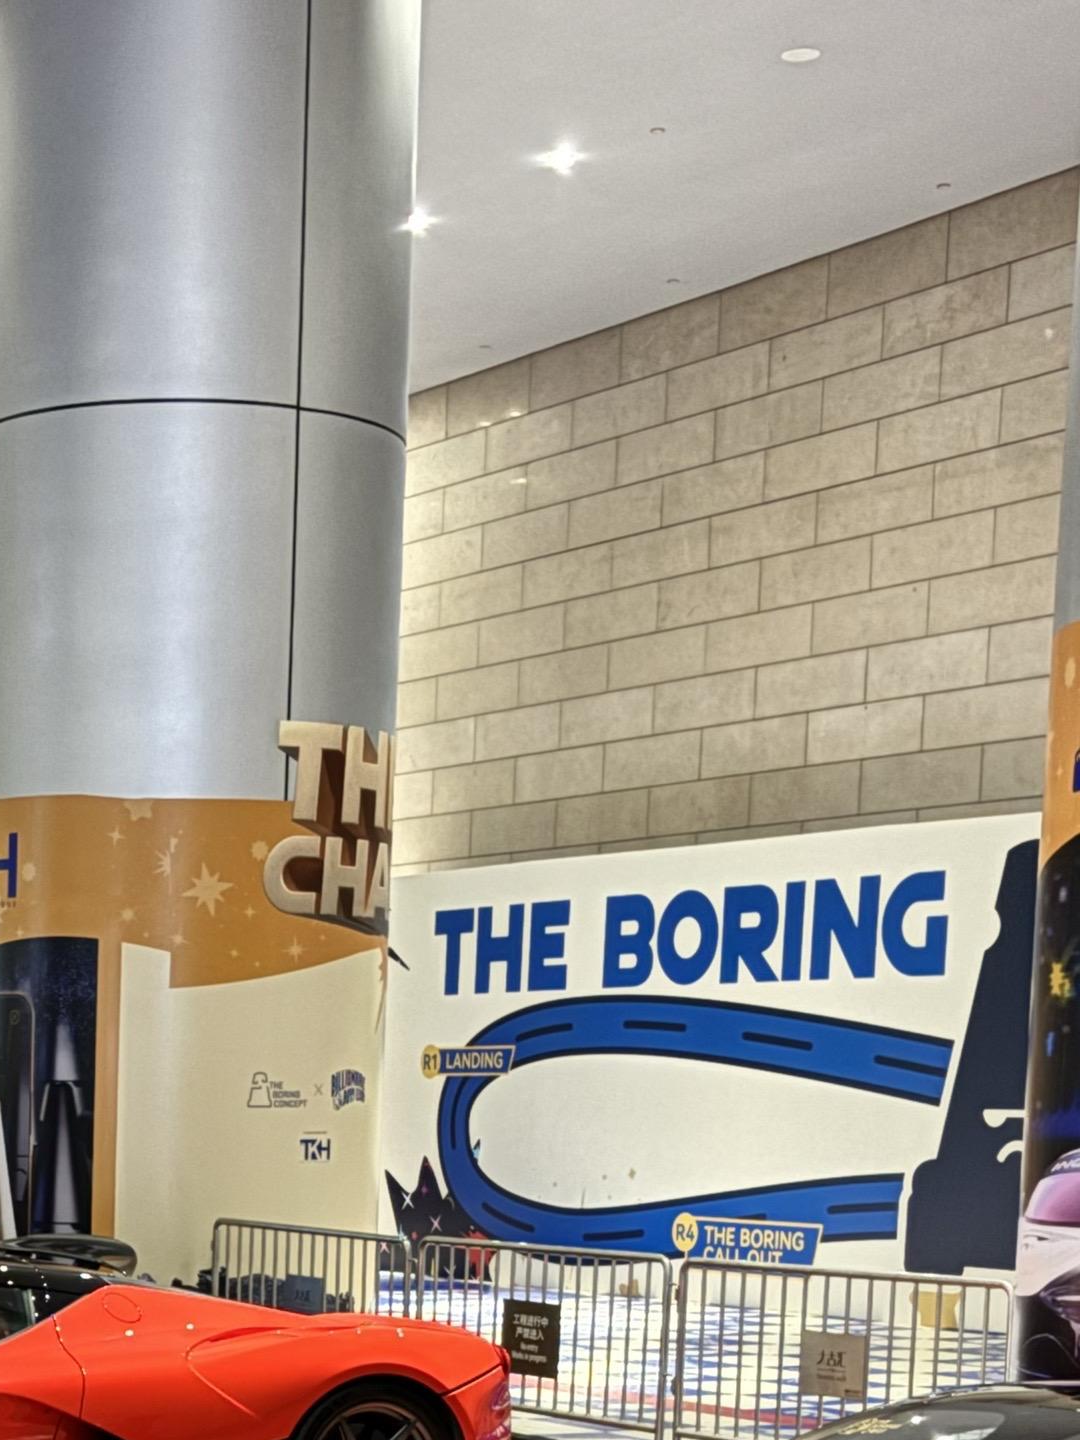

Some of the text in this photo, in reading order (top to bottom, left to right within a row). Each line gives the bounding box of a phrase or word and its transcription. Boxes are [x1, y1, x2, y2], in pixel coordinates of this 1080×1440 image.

[278, 720, 395, 833] TH
[434, 869, 949, 996] THE BORING
[423, 1051, 504, 1070] R1 LANDING
[300, 1138, 331, 1161] TKH
[675, 1223, 805, 1252] R4 THE BORING
